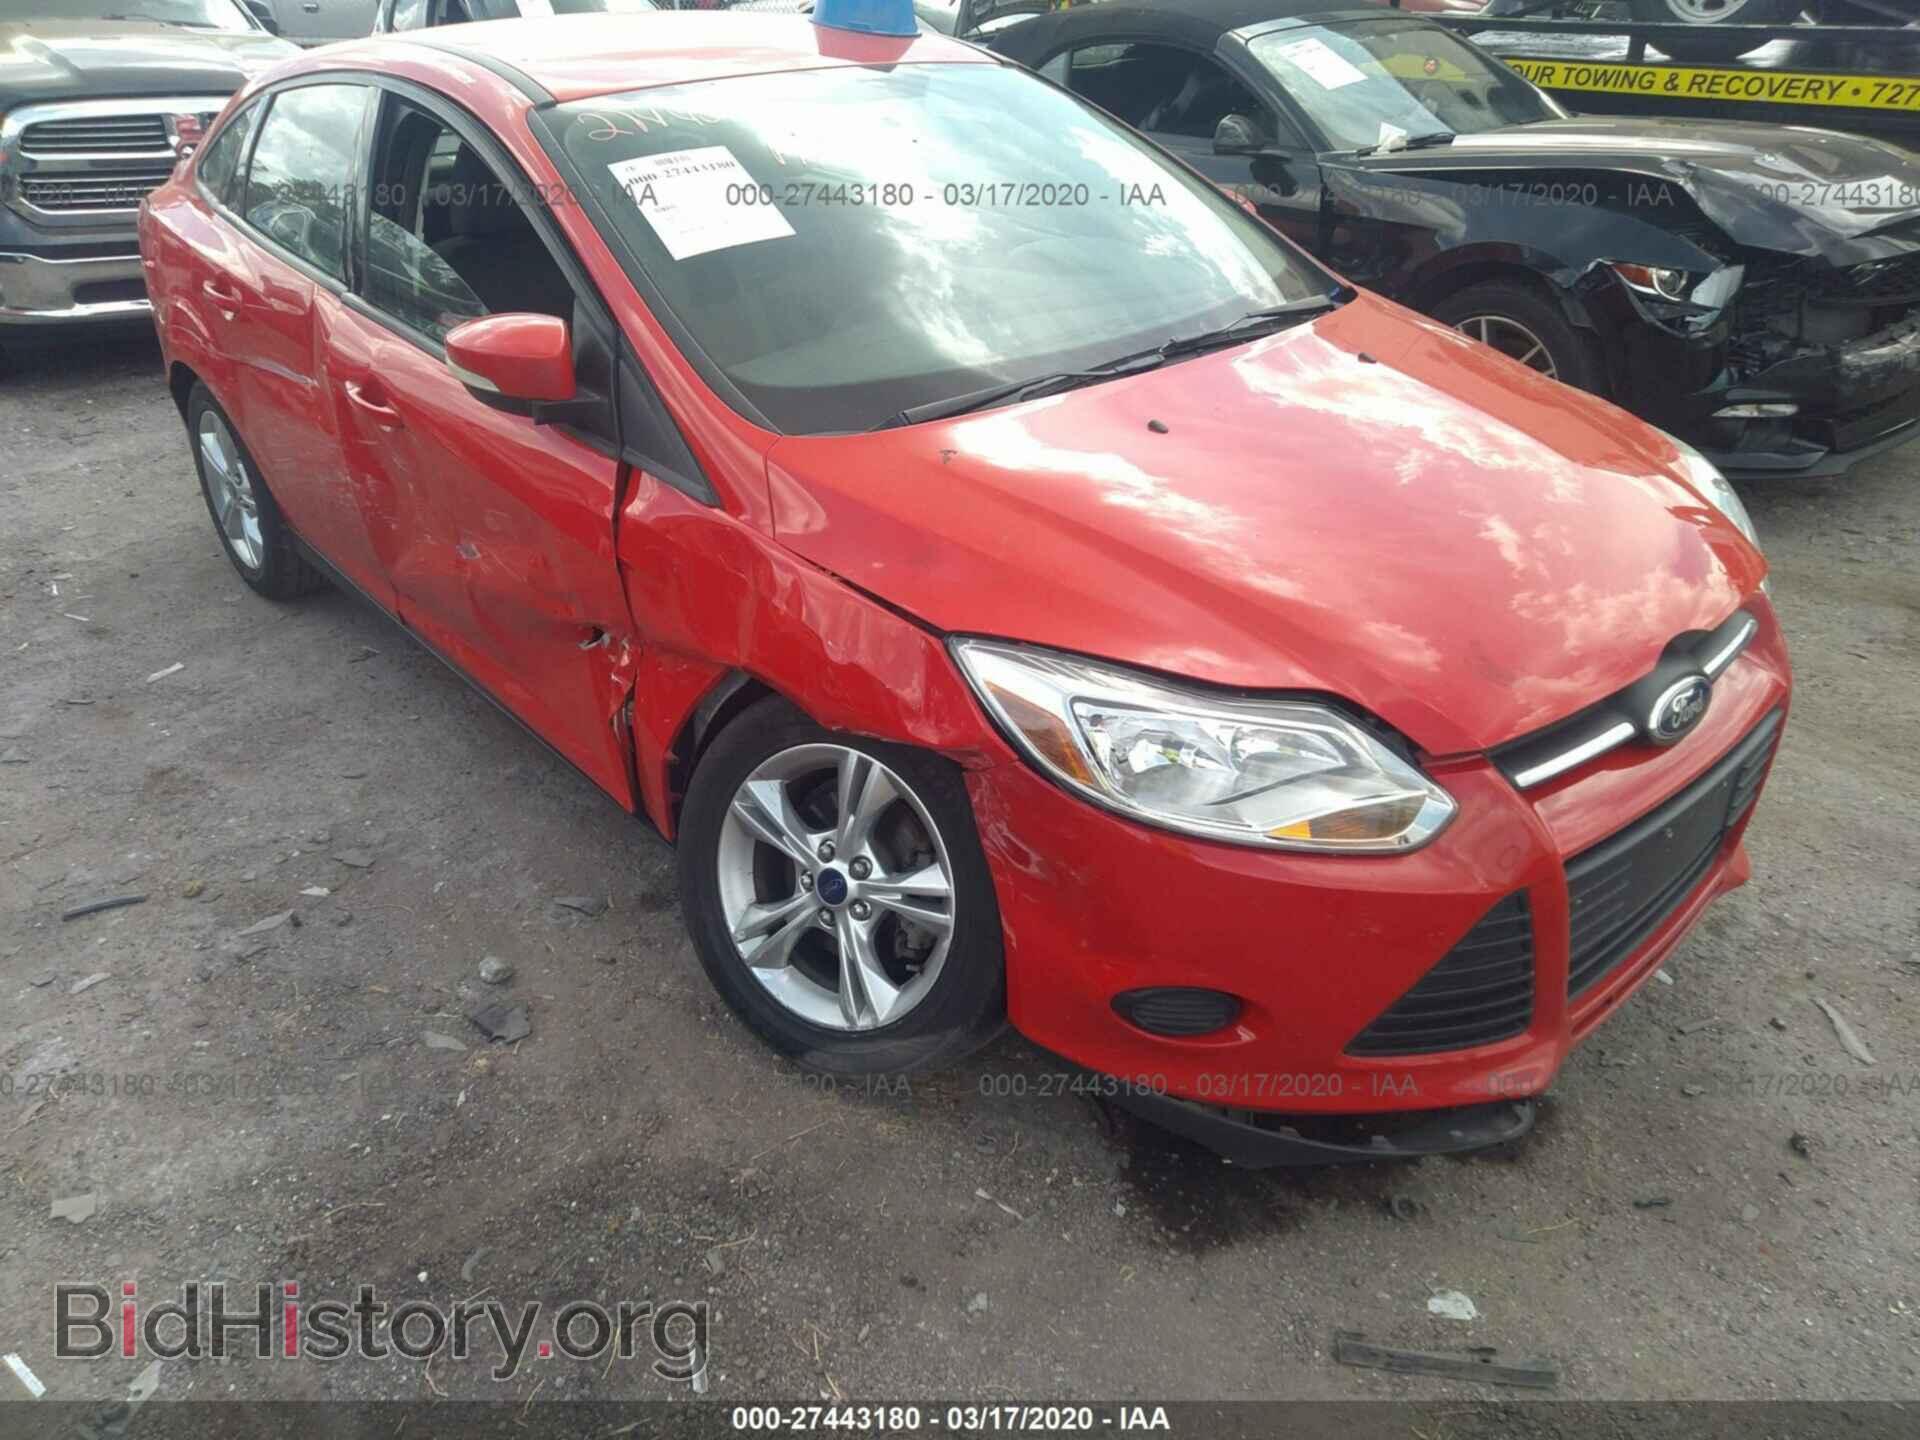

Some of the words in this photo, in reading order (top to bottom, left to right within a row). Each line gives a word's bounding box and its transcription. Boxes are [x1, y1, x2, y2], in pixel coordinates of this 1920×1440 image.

[1563, 67, 1656, 90] TOWING
[1663, 71, 1680, 92] &
[1686, 73, 1847, 100] RECOVERY
